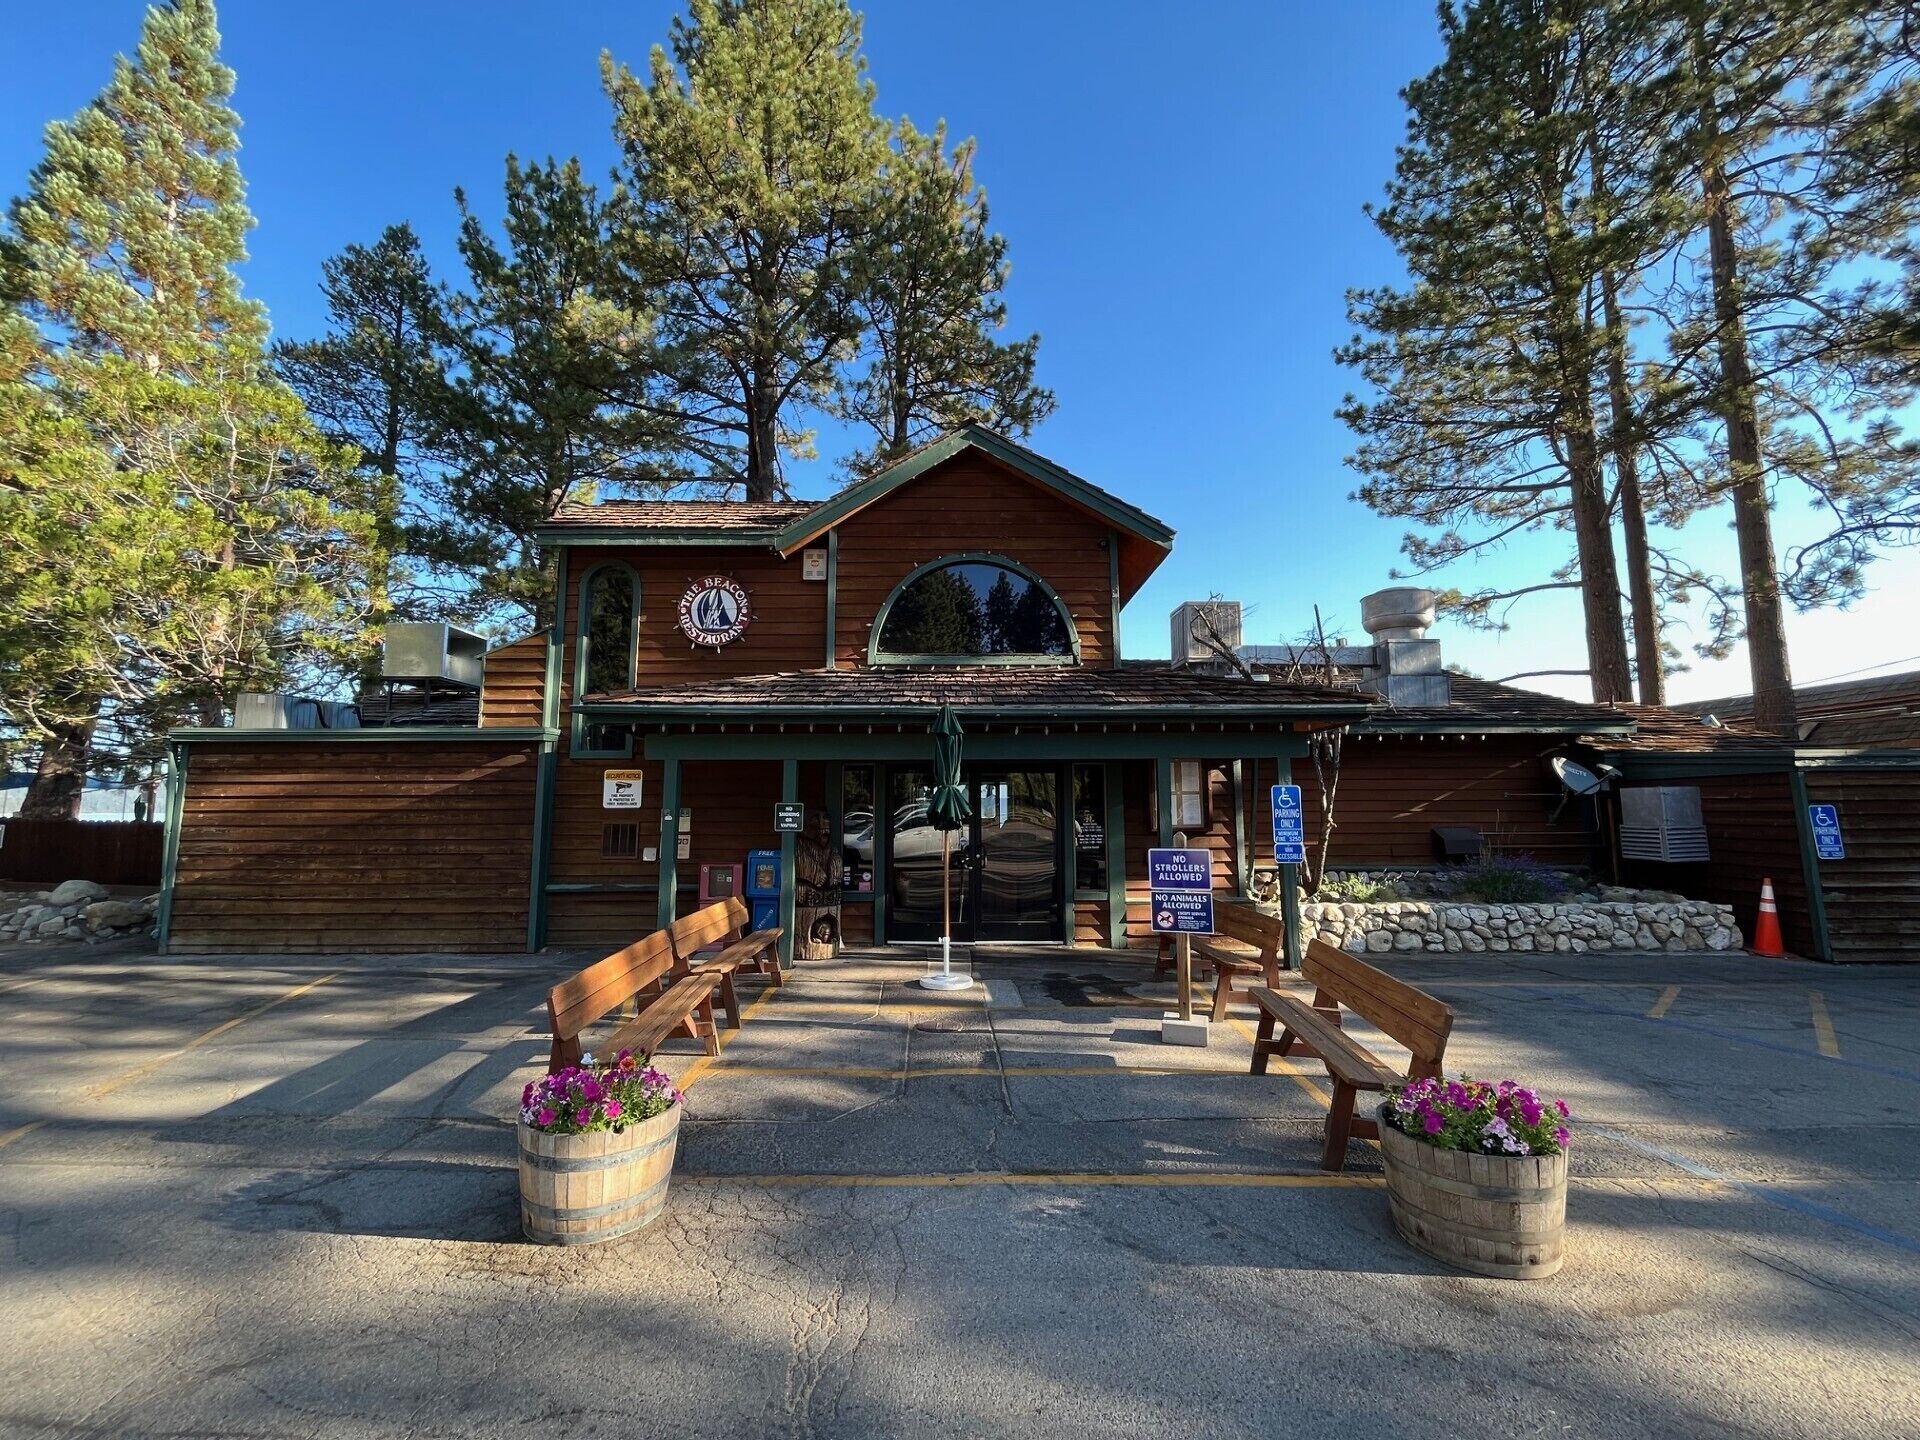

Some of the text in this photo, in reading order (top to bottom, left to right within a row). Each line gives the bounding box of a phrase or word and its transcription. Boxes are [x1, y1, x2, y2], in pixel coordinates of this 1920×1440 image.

[680, 577, 749, 607] THE BEACON
[680, 613, 748, 644] RESTAURANT
[1275, 808, 1300, 818] PARKING
[1280, 819, 1295, 828] ONLY
[1815, 826, 1838, 835] PARKING
[1821, 835, 1835, 845] ONLY
[1172, 855, 1187, 864] NO
[1154, 863, 1206, 872] STROLLERS
[1158, 872, 1203, 882] ALLOWED
[1155, 893, 1208, 903] NO ANIMALS
[1161, 901, 1202, 910] ALLOWED
